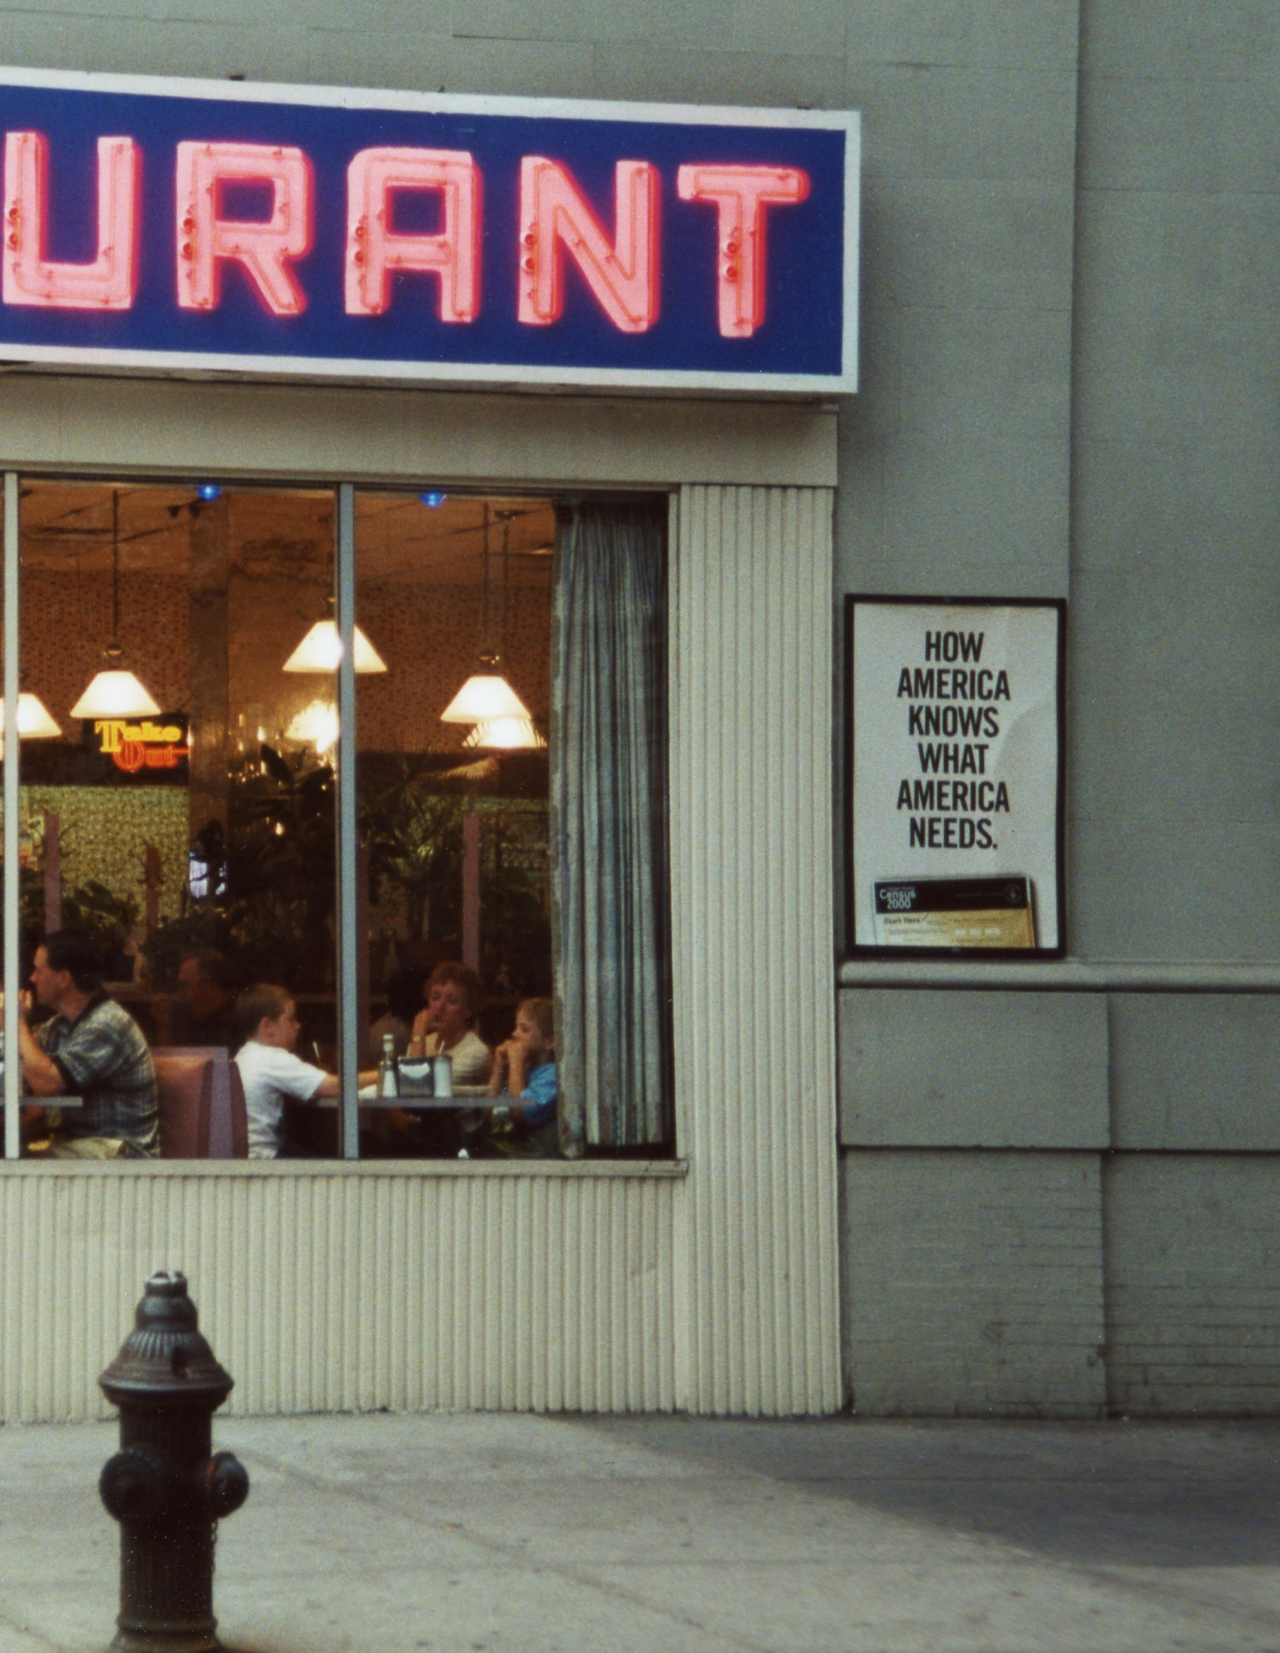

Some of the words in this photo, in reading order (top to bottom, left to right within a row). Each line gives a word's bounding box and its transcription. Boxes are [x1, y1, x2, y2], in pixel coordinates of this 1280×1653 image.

[925, 631, 984, 663] HOW
[897, 668, 1011, 700] AMERICA
[94, 721, 182, 752] Take
[908, 705, 999, 738] KNOWS
[112, 739, 179, 772] Out
[917, 743, 989, 774] WHAT
[897, 779, 1010, 812] AMERICA
[909, 817, 998, 849] NEEDS.
[879, 888, 917, 900] Census
[887, 899, 911, 910] 2000
